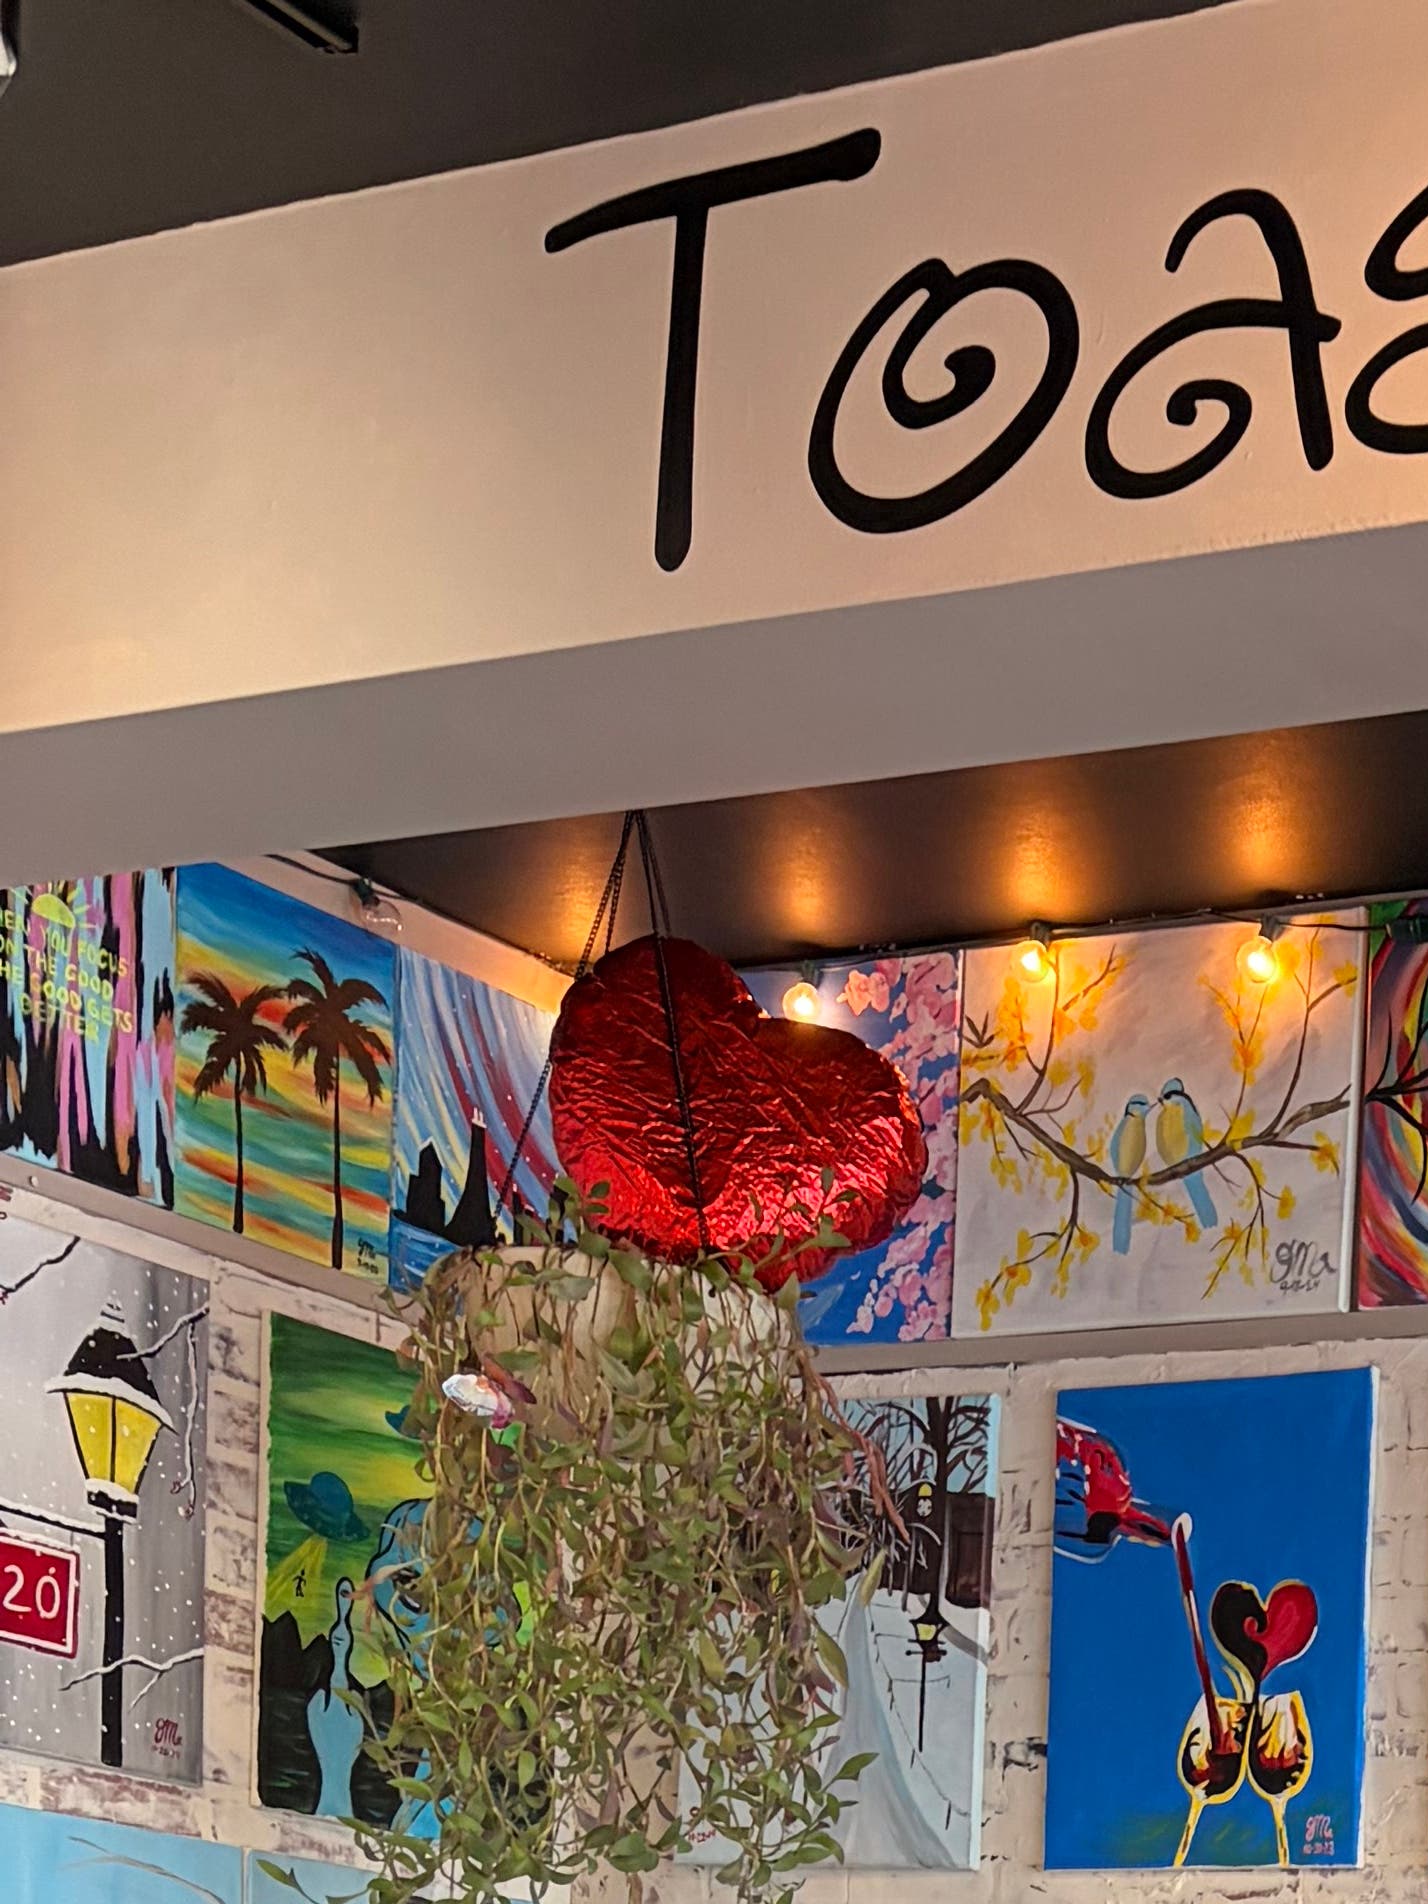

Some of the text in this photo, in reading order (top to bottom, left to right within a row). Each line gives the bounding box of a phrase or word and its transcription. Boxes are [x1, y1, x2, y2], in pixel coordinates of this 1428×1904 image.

[65, 964, 113, 998] GOOD
[78, 938, 129, 977] FOCUS
[30, 973, 82, 1012] GOOD
[87, 998, 133, 1033] GETS
[4, 1564, 60, 1619] 20
